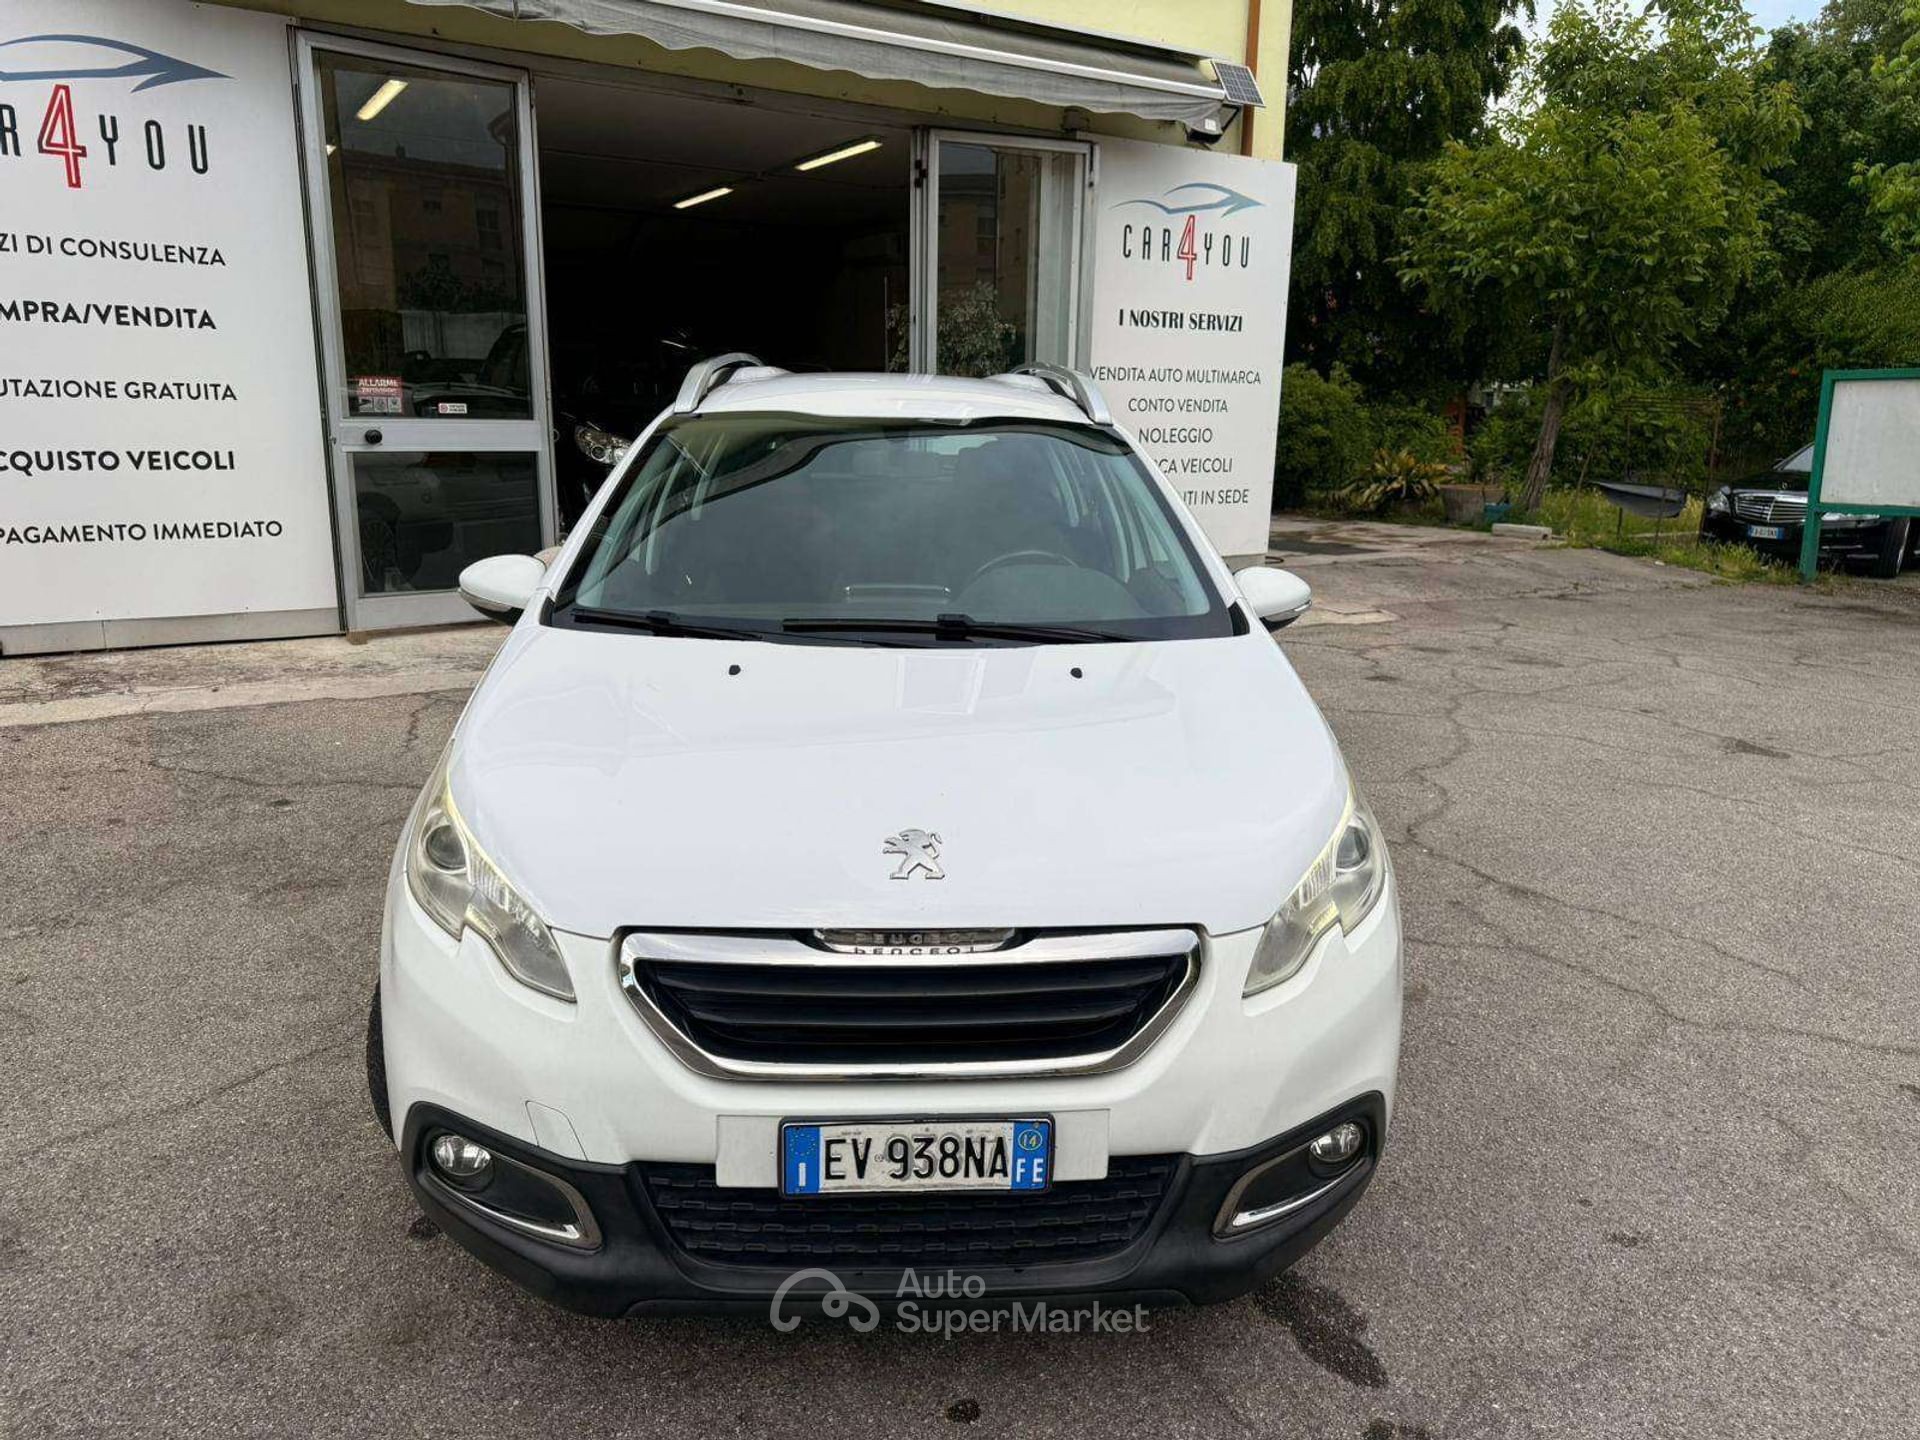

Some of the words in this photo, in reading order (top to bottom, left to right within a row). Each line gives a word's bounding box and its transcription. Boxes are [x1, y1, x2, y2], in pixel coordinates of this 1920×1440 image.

[26, 235, 53, 255] DI
[60, 238, 227, 267] CONSULENZA
[1122, 214, 1250, 281] CAR4YOU
[1119, 309, 1125, 327] I
[1129, 309, 1185, 330] NOSTRI
[1188, 313, 1243, 333] SERVIZI
[1090, 366, 1147, 382] VENDITA
[1148, 368, 1184, 383] AUTO
[1186, 369, 1262, 385] MULTIMARCA
[124, 381, 239, 401] GRATUITA
[1127, 398, 1175, 413] CONTO
[1177, 399, 1229, 413] VENDITA
[1138, 428, 1214, 444] NOLEGGIO
[126, 450, 236, 471] VEICOLI
[1180, 458, 1233, 474] VEICOLI
[1200, 490, 1216, 505] IN
[1217, 489, 1250, 505] SEDE
[153, 520, 283, 541] IMMEDIATO
[824, 1137, 872, 1181] EV
[887, 1135, 1009, 1180] 938NA
